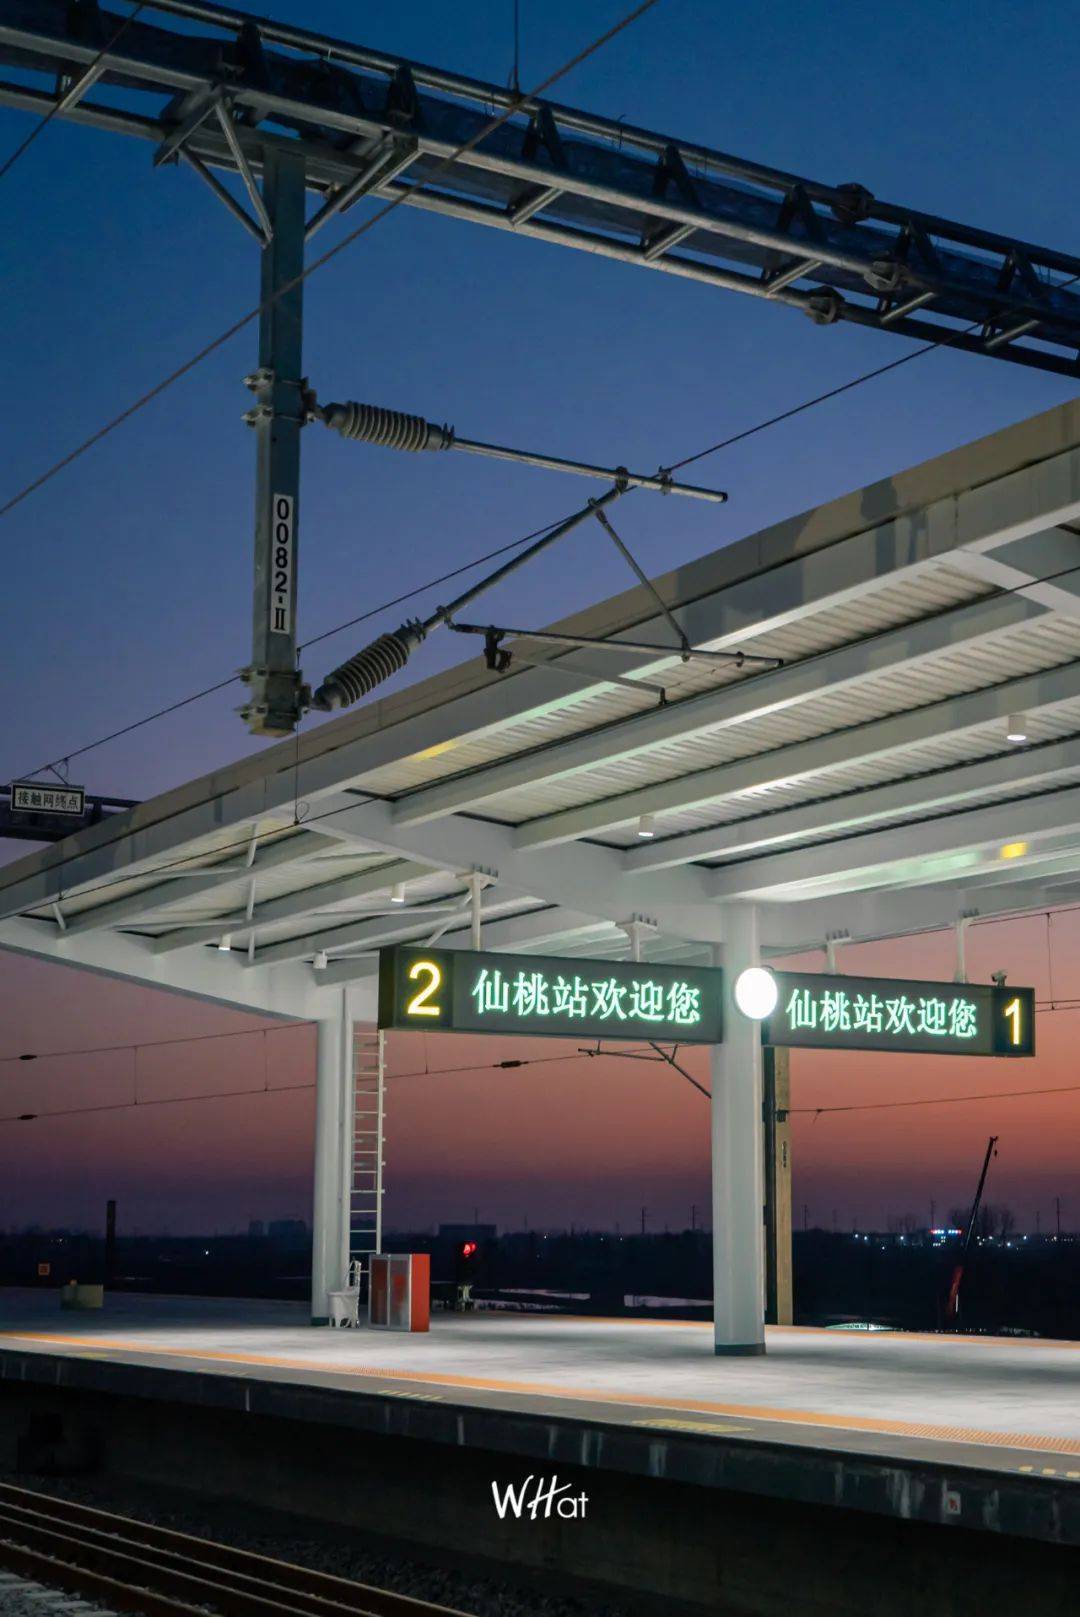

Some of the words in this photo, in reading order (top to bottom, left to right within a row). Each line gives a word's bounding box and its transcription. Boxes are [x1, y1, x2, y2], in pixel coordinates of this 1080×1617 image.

[407, 961, 441, 1016] 2
[471, 969, 701, 1025] 仙桃站欢迎您
[785, 988, 978, 1038] 仙桃站欢迎您
[1004, 998, 1020, 1046] 1
